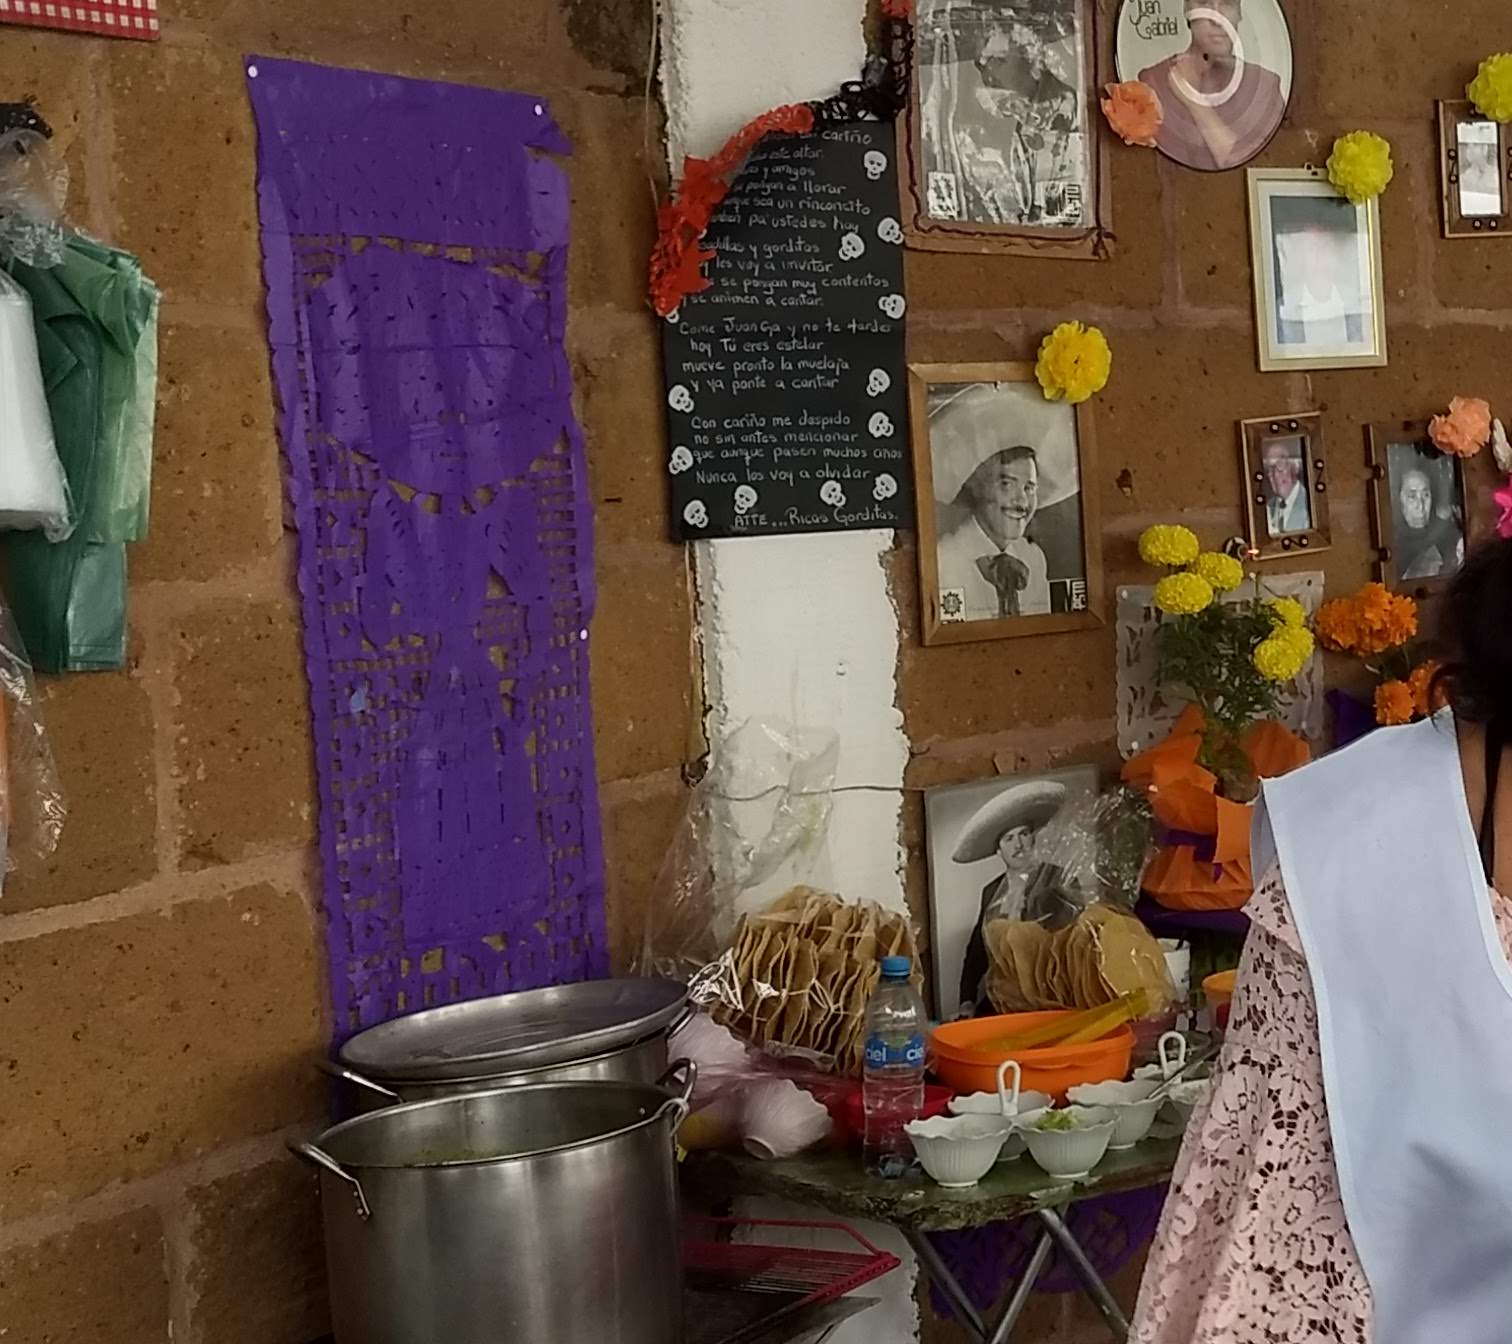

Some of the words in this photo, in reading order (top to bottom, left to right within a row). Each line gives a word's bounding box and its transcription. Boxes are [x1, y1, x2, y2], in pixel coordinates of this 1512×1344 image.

[1135, 13, 1179, 40] Gabriel
[822, 129, 872, 145] cariño
[772, 164, 816, 182] amigos
[787, 183, 797, 192] a
[803, 180, 848, 195] llorar
[777, 200, 794, 210] un
[799, 196, 871, 216] rinconcito
[749, 243, 758, 258] y
[738, 260, 760, 277] voy
[764, 261, 776, 271] a
[721, 276, 738, 287] se
[792, 279, 817, 295] muy
[822, 272, 890, 288] contentos
[711, 291, 760, 305] animen
[765, 296, 776, 307] a
[787, 324, 796, 338] y
[802, 322, 819, 332] no
[825, 317, 841, 332] te
[690, 338, 712, 358] hoy
[743, 342, 770, 353] eres
[776, 336, 824, 352] estelar
[682, 361, 725, 372] mueve
[733, 356, 775, 378] pronto
[780, 356, 793, 371] la
[690, 379, 699, 393] y
[706, 377, 724, 393] ya
[732, 375, 766, 395] ponte
[775, 379, 785, 390] a
[791, 374, 840, 390] cantar
[691, 416, 716, 429] Con
[723, 413, 766, 429] cariño
[772, 416, 792, 427] me
[799, 409, 850, 430] despido
[694, 433, 709, 445] no
[715, 432, 735, 445] sin
[740, 430, 778, 444] antes
[784, 431, 859, 443] mencionar
[693, 449, 715, 464] que
[721, 447, 765, 466] aunque
[773, 447, 816, 463] pasen
[823, 447, 868, 458] muchos
[696, 470, 737, 484] Nunca
[746, 467, 764, 482] los
[769, 471, 794, 487] voy
[799, 469, 810, 479] a
[815, 462, 871, 479] olvidar
